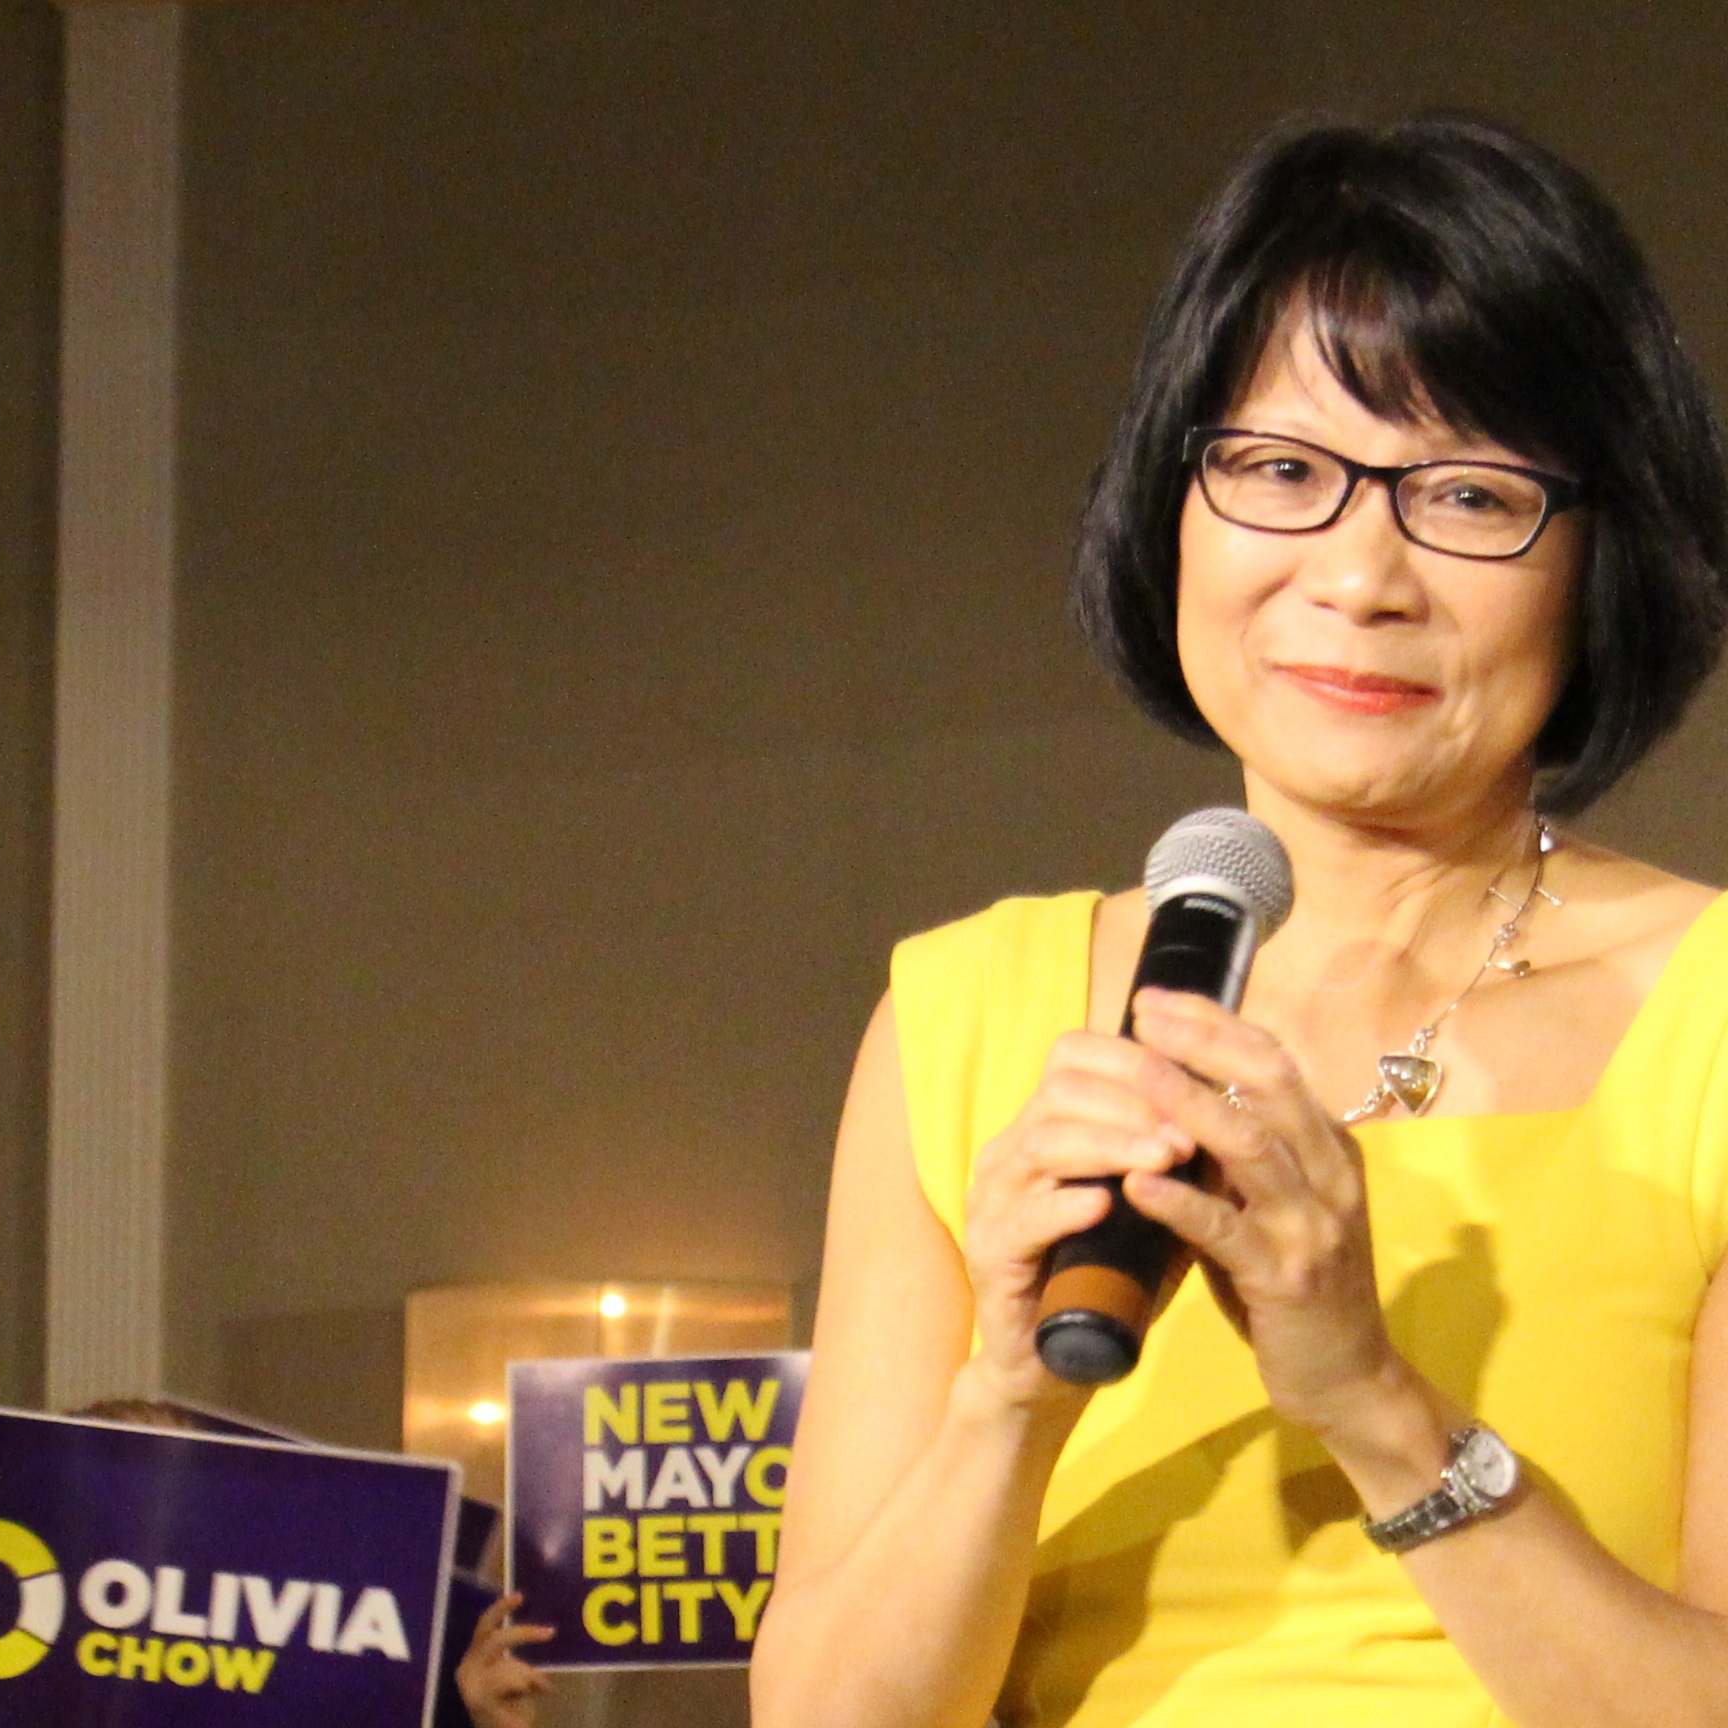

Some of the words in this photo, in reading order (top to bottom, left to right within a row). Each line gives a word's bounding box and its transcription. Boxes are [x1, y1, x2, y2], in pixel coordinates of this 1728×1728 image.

[583, 1378, 781, 1446] NEW
[583, 1445, 793, 1511] MAYO
[583, 1512, 783, 1579] BETT
[79, 1558, 411, 1663] OLIVIA
[582, 1579, 773, 1647] CITY
[76, 1630, 276, 1694] CHOW
